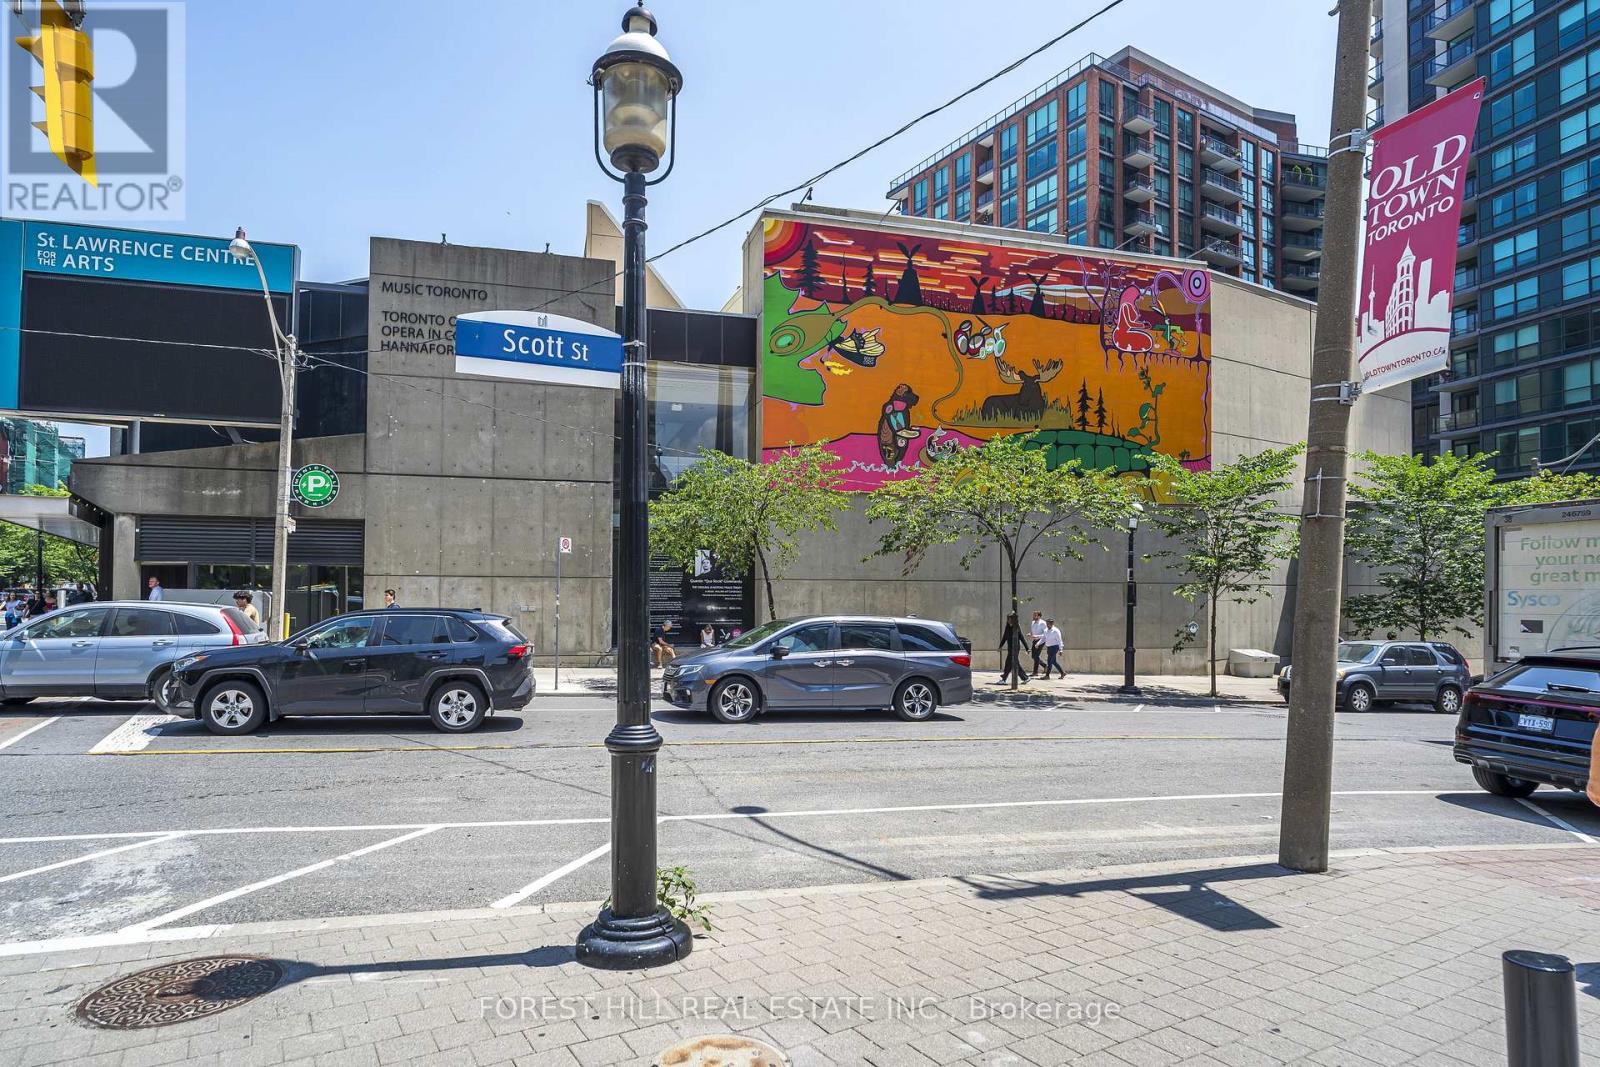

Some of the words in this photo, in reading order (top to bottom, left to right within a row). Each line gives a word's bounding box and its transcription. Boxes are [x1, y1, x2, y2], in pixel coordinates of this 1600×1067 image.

[1371, 134, 1467, 200] OLD
[1368, 165, 1462, 228] TOWN
[1367, 196, 1455, 246] TORONTO
[37, 232, 58, 249] St.
[63, 235, 174, 259] LAWRENCE
[37, 250, 56, 259] FOR
[38, 257, 56, 267] THE
[62, 254, 115, 272] ARTS
[381, 281, 424, 296] MUSIC
[425, 285, 488, 301] TORONTO
[381, 310, 445, 327] TORONTO
[381, 325, 424, 340] OPERA
[428, 327, 441, 341] IN
[502, 328, 564, 359] Scott
[571, 342, 589, 362] St
[308, 475, 326, 493] P
[1520, 534, 1580, 551] Follow
[1535, 554, 1578, 570] your
[1530, 569, 1580, 586] great
[1507, 590, 1561, 609] Sysco
